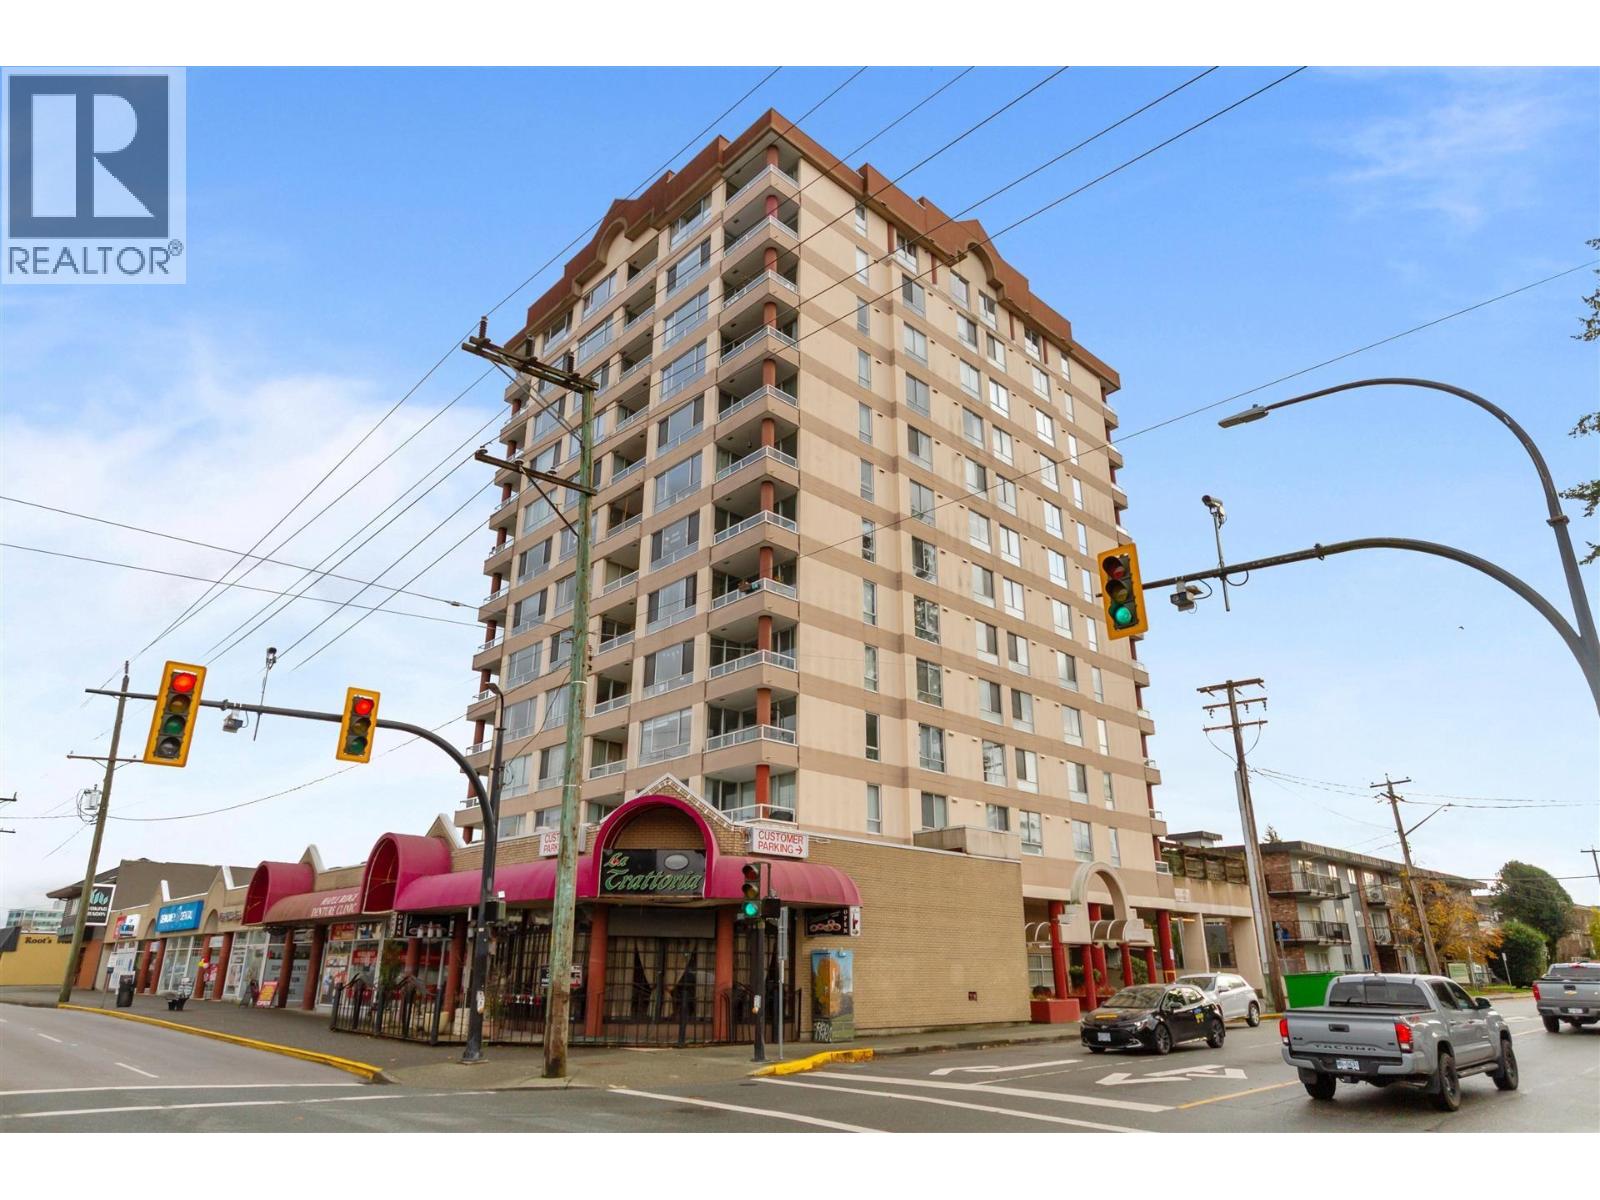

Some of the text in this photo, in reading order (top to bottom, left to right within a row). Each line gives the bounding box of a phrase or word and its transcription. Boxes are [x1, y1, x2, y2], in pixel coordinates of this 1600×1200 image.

[758, 830, 804, 844] CUSTOMER
[757, 840, 794, 854] PARKING
[604, 868, 703, 891] Trattoria
[1314, 1044, 1377, 1052] TACOMA
